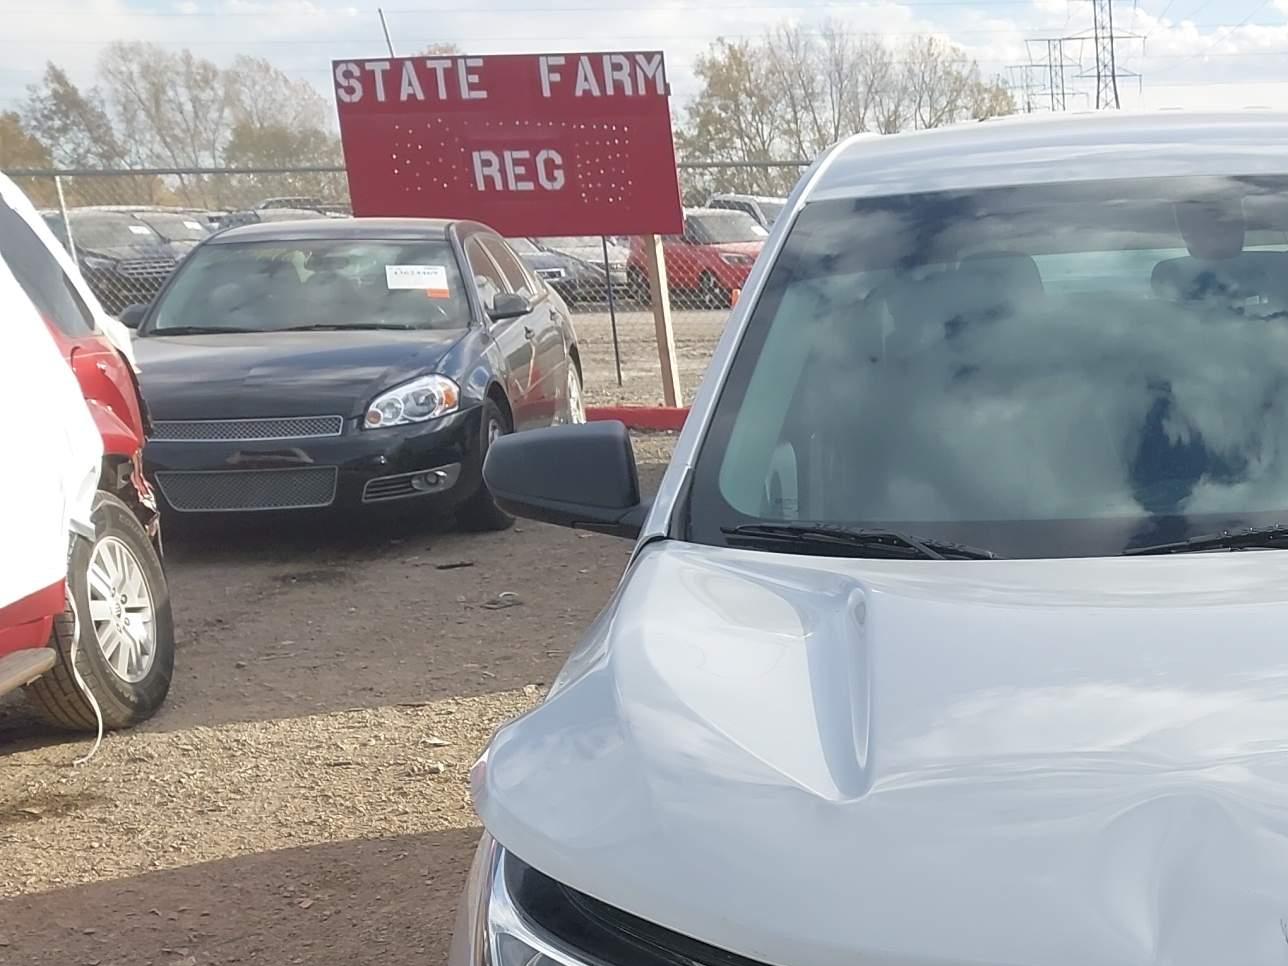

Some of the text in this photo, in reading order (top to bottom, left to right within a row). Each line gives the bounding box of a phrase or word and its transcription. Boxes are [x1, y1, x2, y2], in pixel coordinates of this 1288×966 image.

[335, 55, 666, 102] STATE FARM
[472, 151, 566, 191] REG
